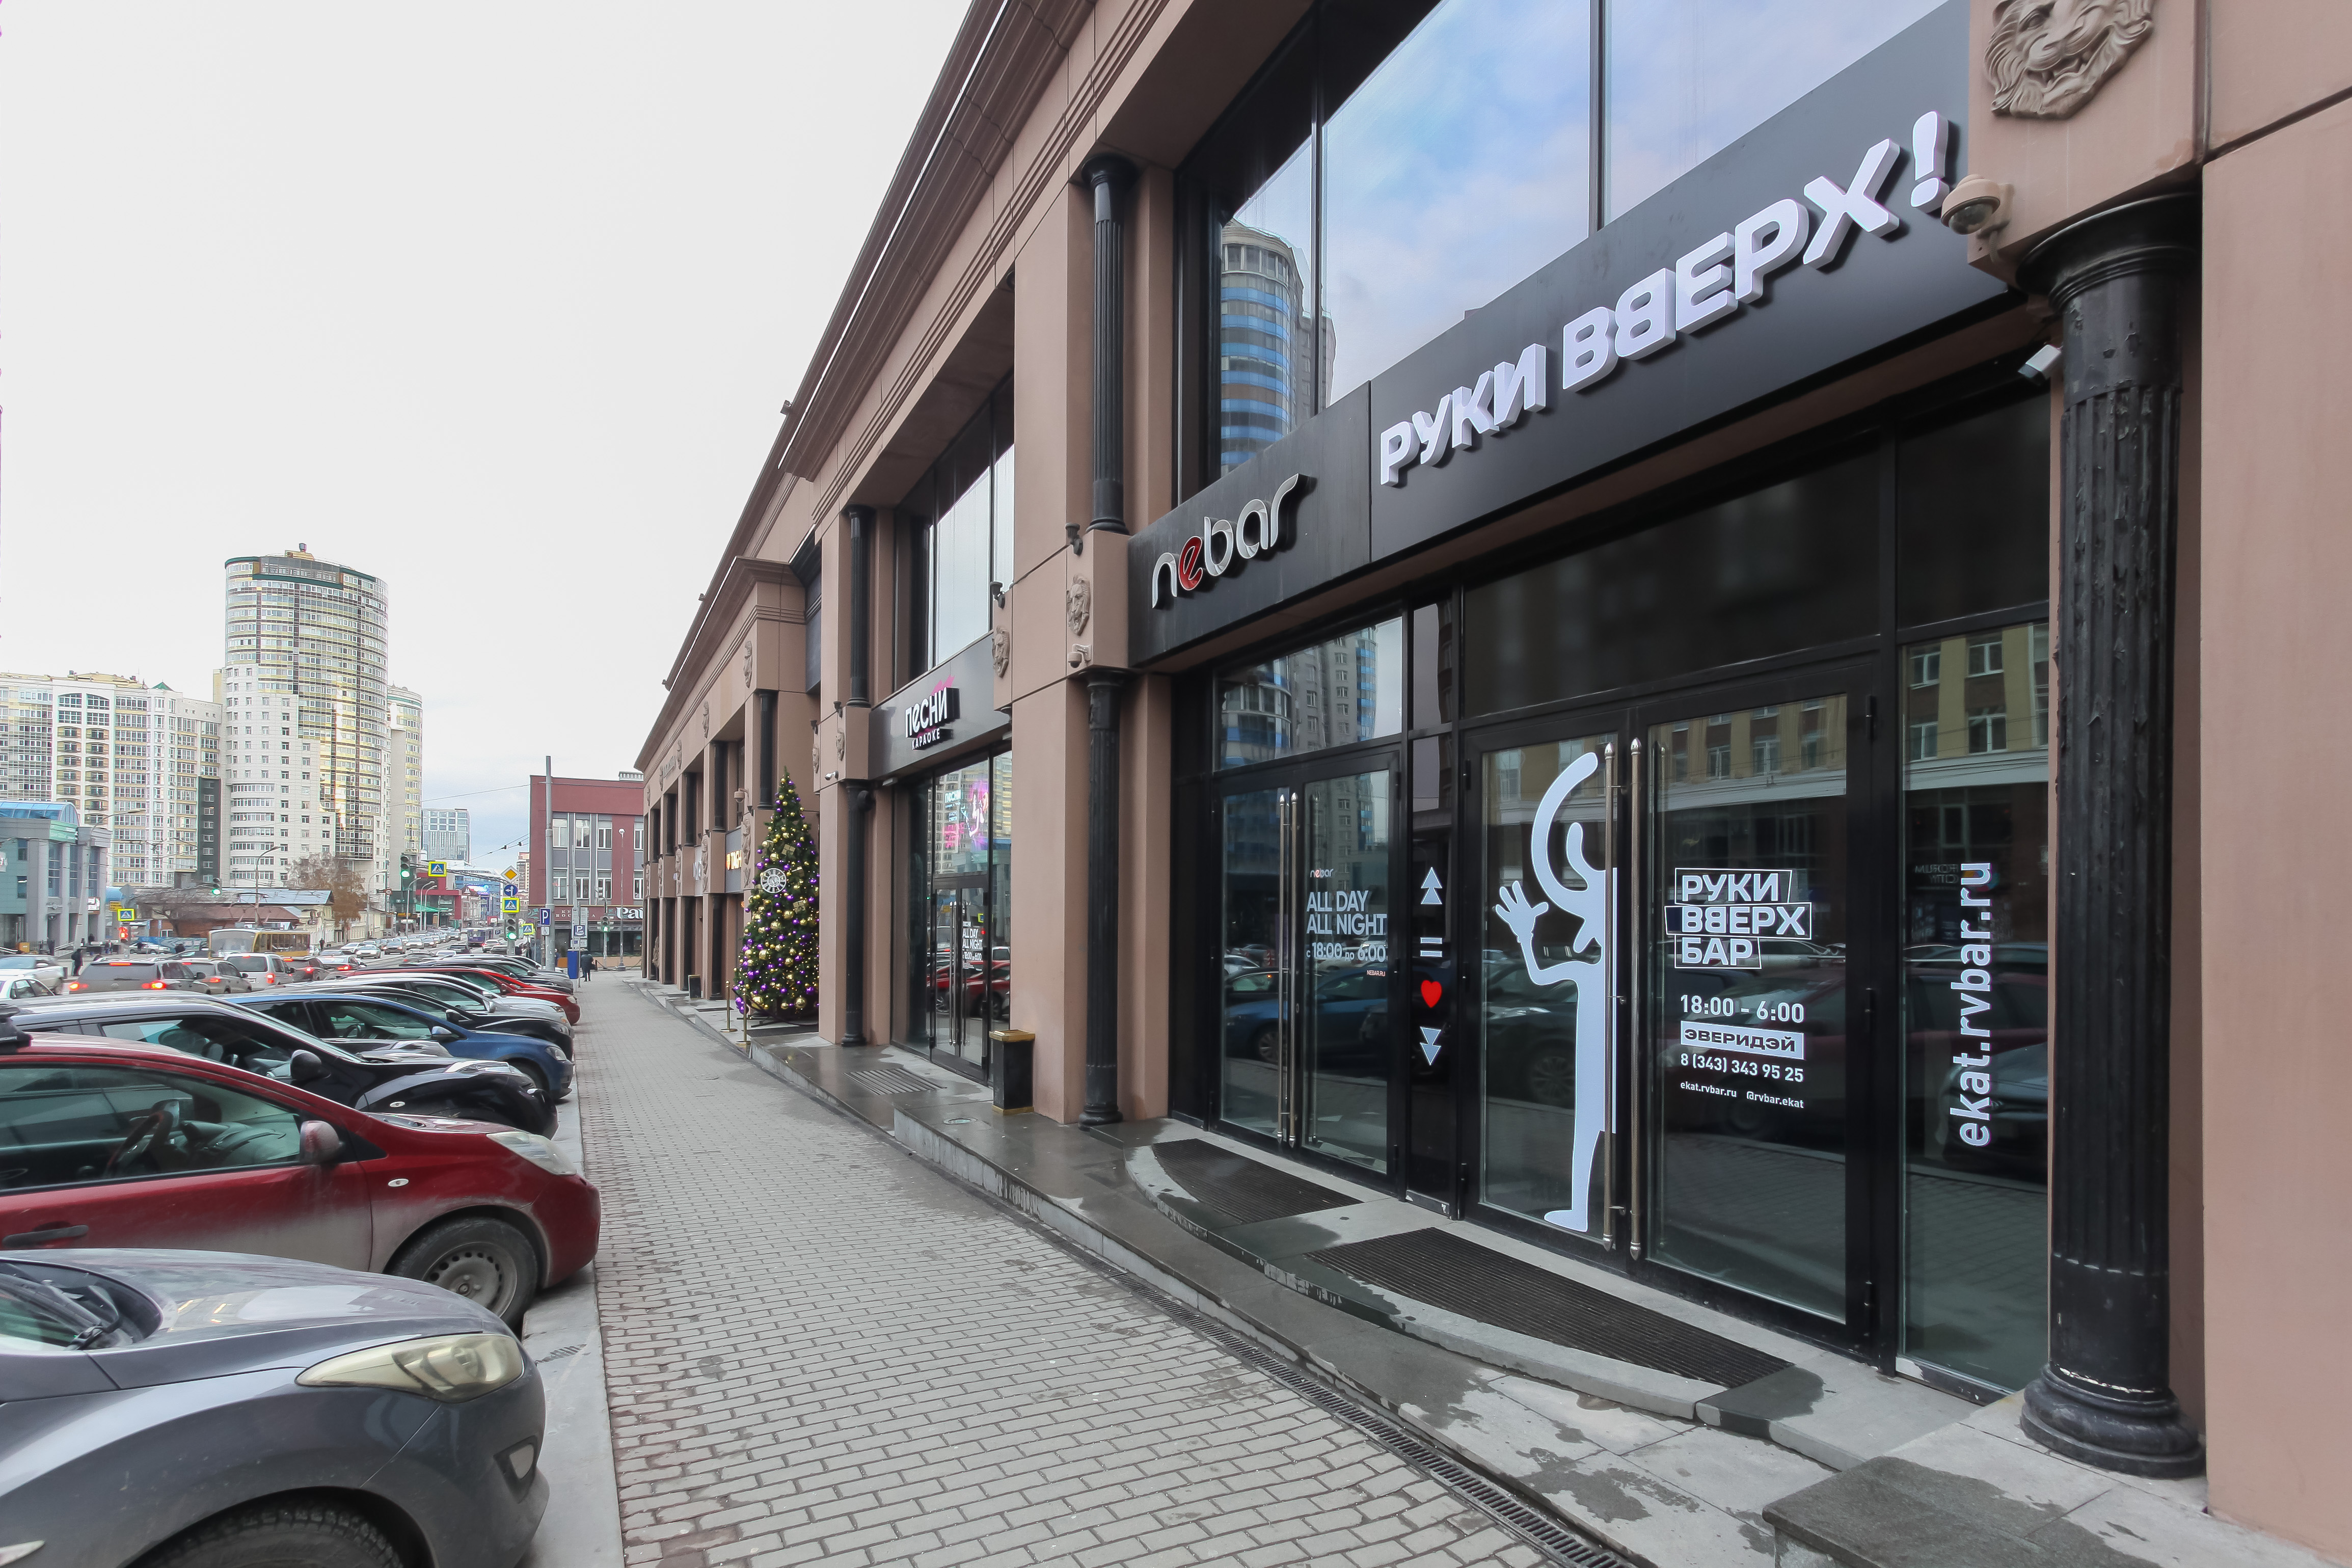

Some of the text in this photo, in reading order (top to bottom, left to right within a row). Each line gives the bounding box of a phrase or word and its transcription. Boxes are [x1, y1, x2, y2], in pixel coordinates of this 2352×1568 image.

[1380, 343, 1546, 487] РУКИ
[1152, 473, 1299, 609] nebar
[912, 727, 940, 750] КАРАОКЕ
[1310, 868, 1334, 878] nebar
[1307, 890, 1369, 912] ALL DAY
[1682, 873, 1779, 902] РУКИ
[970, 928, 978, 938] DAY
[1307, 913, 1387, 935] ALL NIGHT
[1682, 906, 1806, 936] ВВЕРХ
[1312, 942, 1342, 959] 18:00
[1344, 952, 1355, 961] до
[1357, 944, 1386, 962] 6:00
[1682, 938, 1753, 965] БАР
[1681, 994, 1734, 1017] 18:00
[1756, 1001, 1804, 1023] 6:00
[1950, 862, 1991, 1147] ekat.rvbar.ru
[1684, 1029, 1796, 1052] ЭВЕРИДЭЙ
[1681, 1053, 1804, 1083] 8 (343) 343 95 25
[1680, 1081, 1804, 1109] ekat.rvbar.ru @rvbar.ekat
